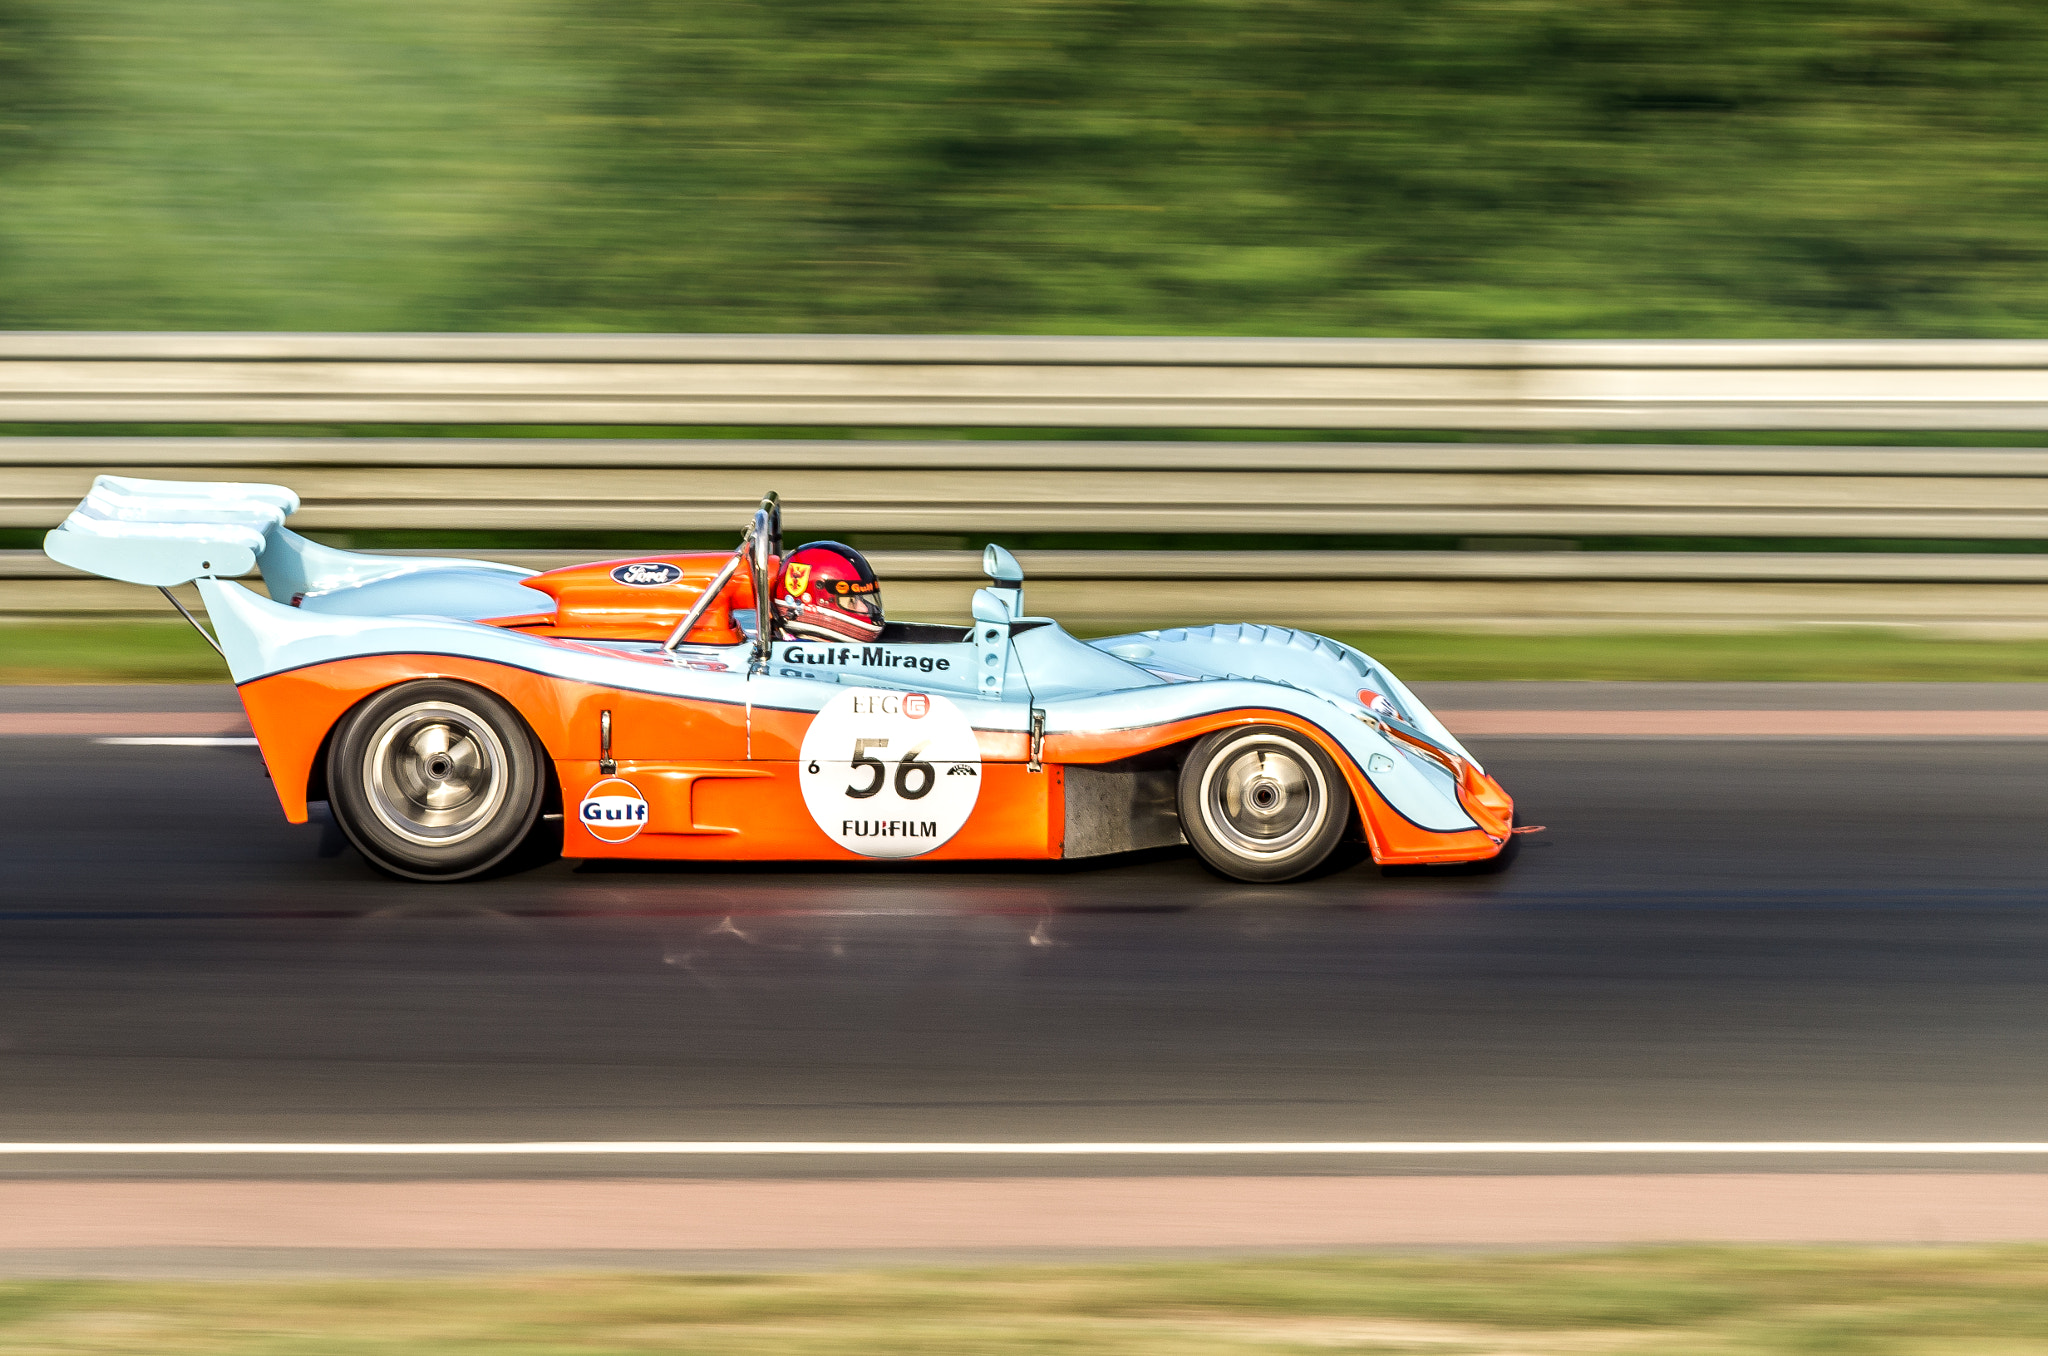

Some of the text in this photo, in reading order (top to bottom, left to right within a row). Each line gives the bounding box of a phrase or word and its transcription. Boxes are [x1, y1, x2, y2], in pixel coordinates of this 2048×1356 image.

[624, 564, 669, 583] Ford
[783, 646, 950, 672] Gulf-Mirage
[853, 696, 898, 713] EFG
[845, 738, 936, 800] 56
[583, 802, 645, 820] Gulf
[842, 820, 937, 837] FUJIFILM
